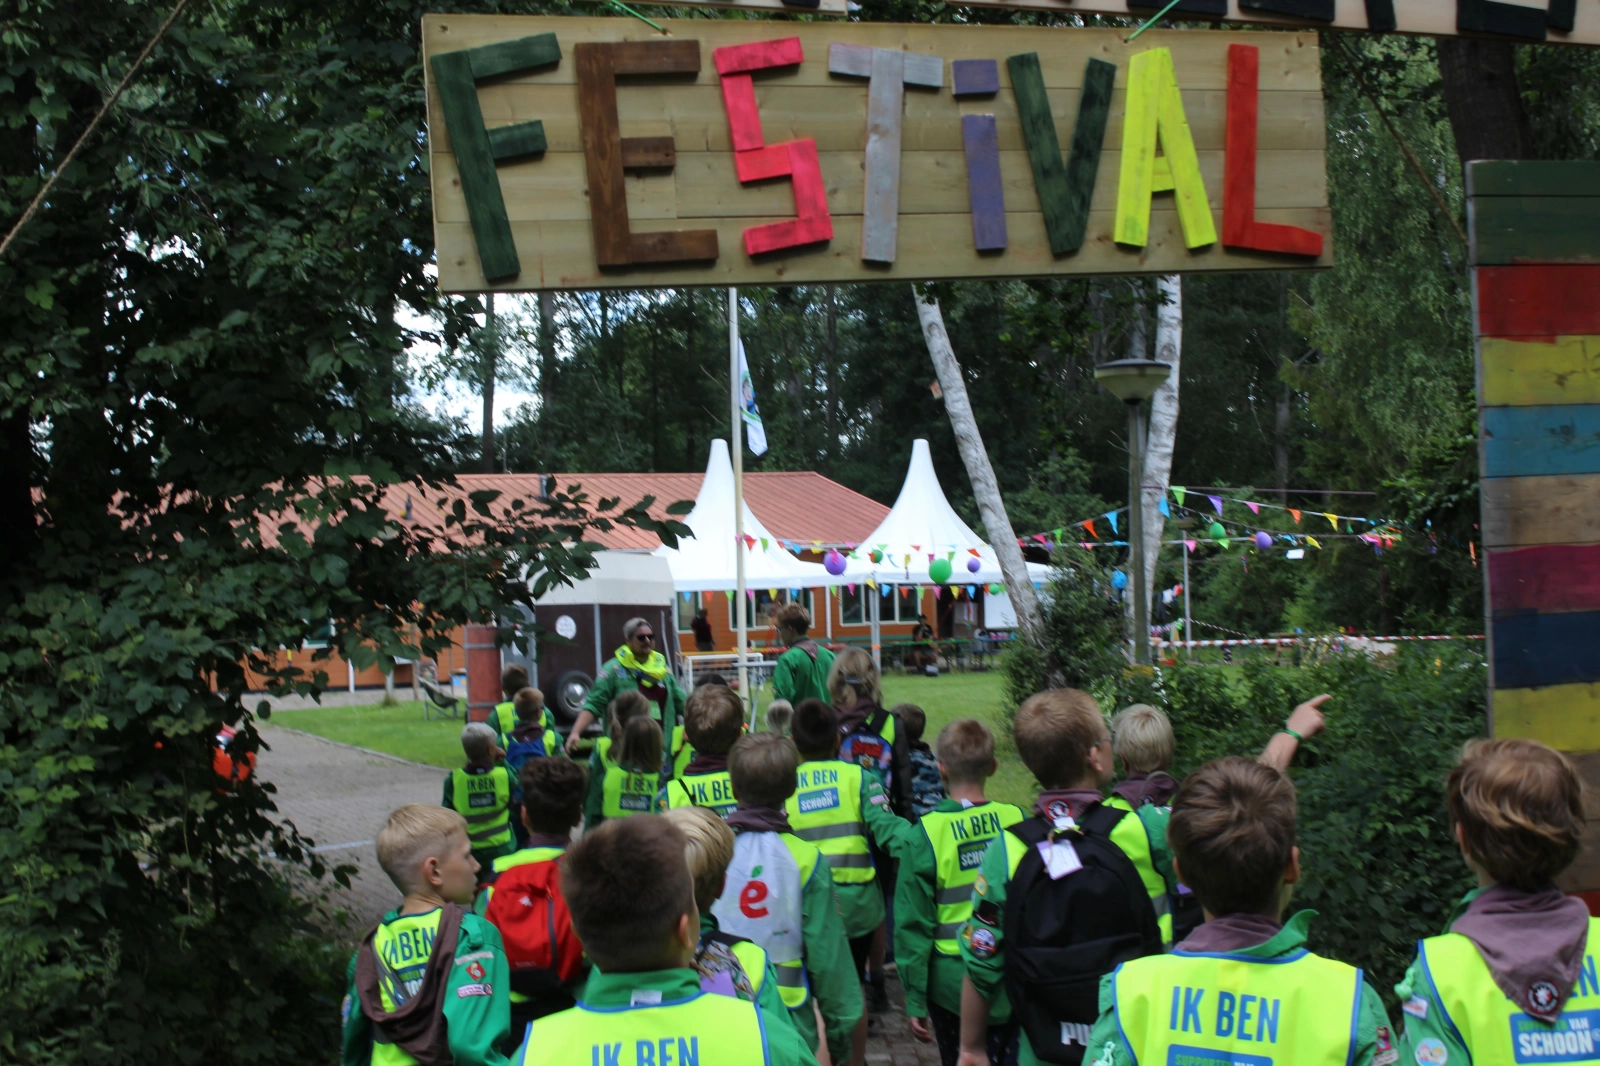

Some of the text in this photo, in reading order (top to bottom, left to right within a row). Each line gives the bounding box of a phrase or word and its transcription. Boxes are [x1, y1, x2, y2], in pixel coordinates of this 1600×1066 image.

[478, 777, 496, 790] BEN
[813, 769, 838, 785] BEN
[691, 779, 733, 804] IK BE
[800, 796, 834, 811] SCHOON
[950, 811, 1001, 841] IK BEN
[960, 849, 985, 867] SCHO
[399, 927, 437, 962] BEN
[1169, 985, 1281, 1044] IK BEN
[1568, 1017, 1590, 1030] VAN
[1060, 1021, 1093, 1047] PU
[1518, 1029, 1595, 1057] SCHOON
[591, 1035, 699, 1066] IK BEN
